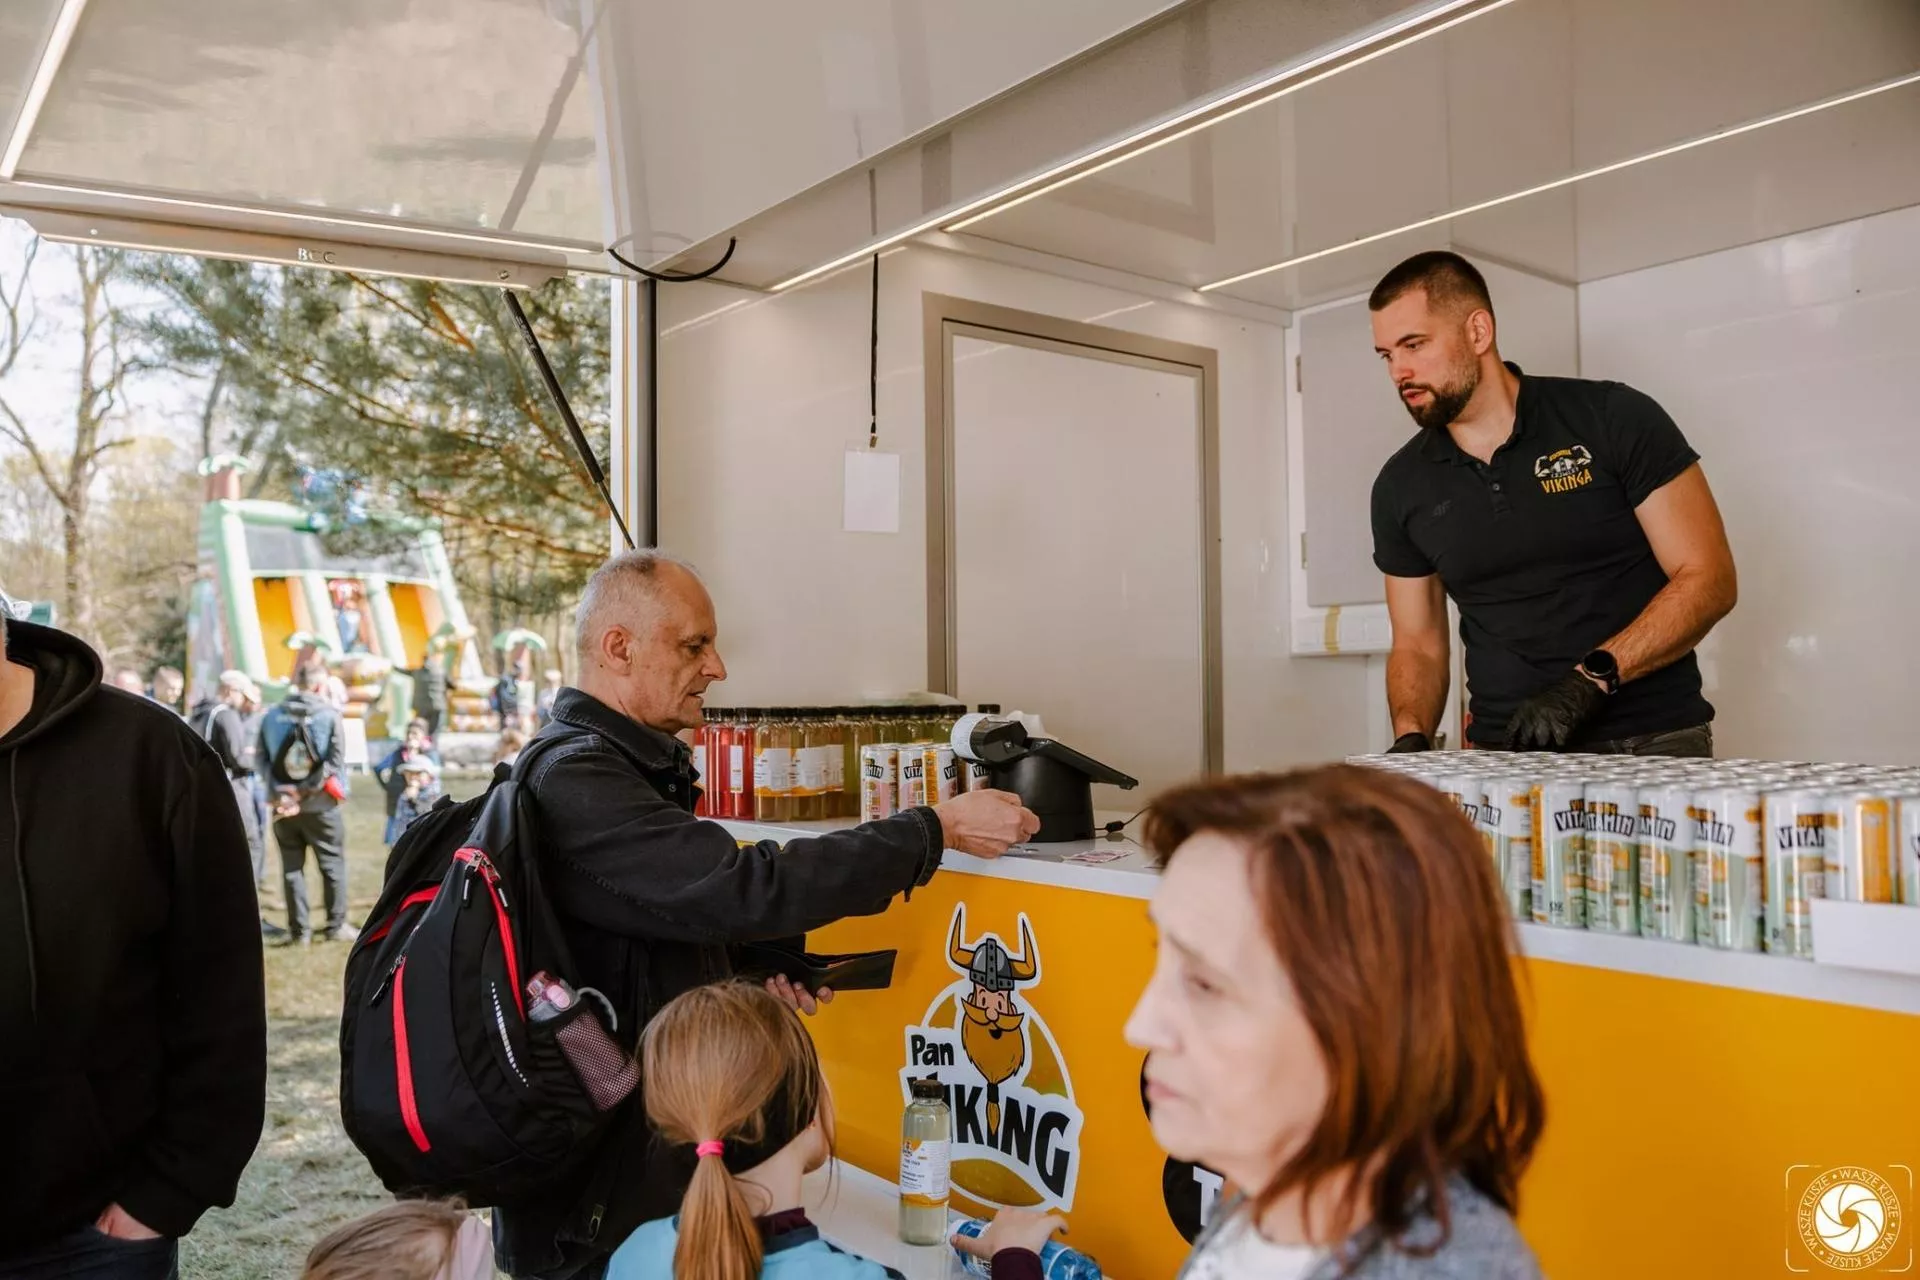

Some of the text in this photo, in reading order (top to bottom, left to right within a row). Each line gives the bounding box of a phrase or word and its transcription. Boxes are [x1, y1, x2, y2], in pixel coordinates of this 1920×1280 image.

[1541, 469, 1592, 493] VIKINGA
[1554, 810, 1585, 831] VITA
[911, 1034, 954, 1066] Pan
[907, 1072, 1070, 1198] KING
